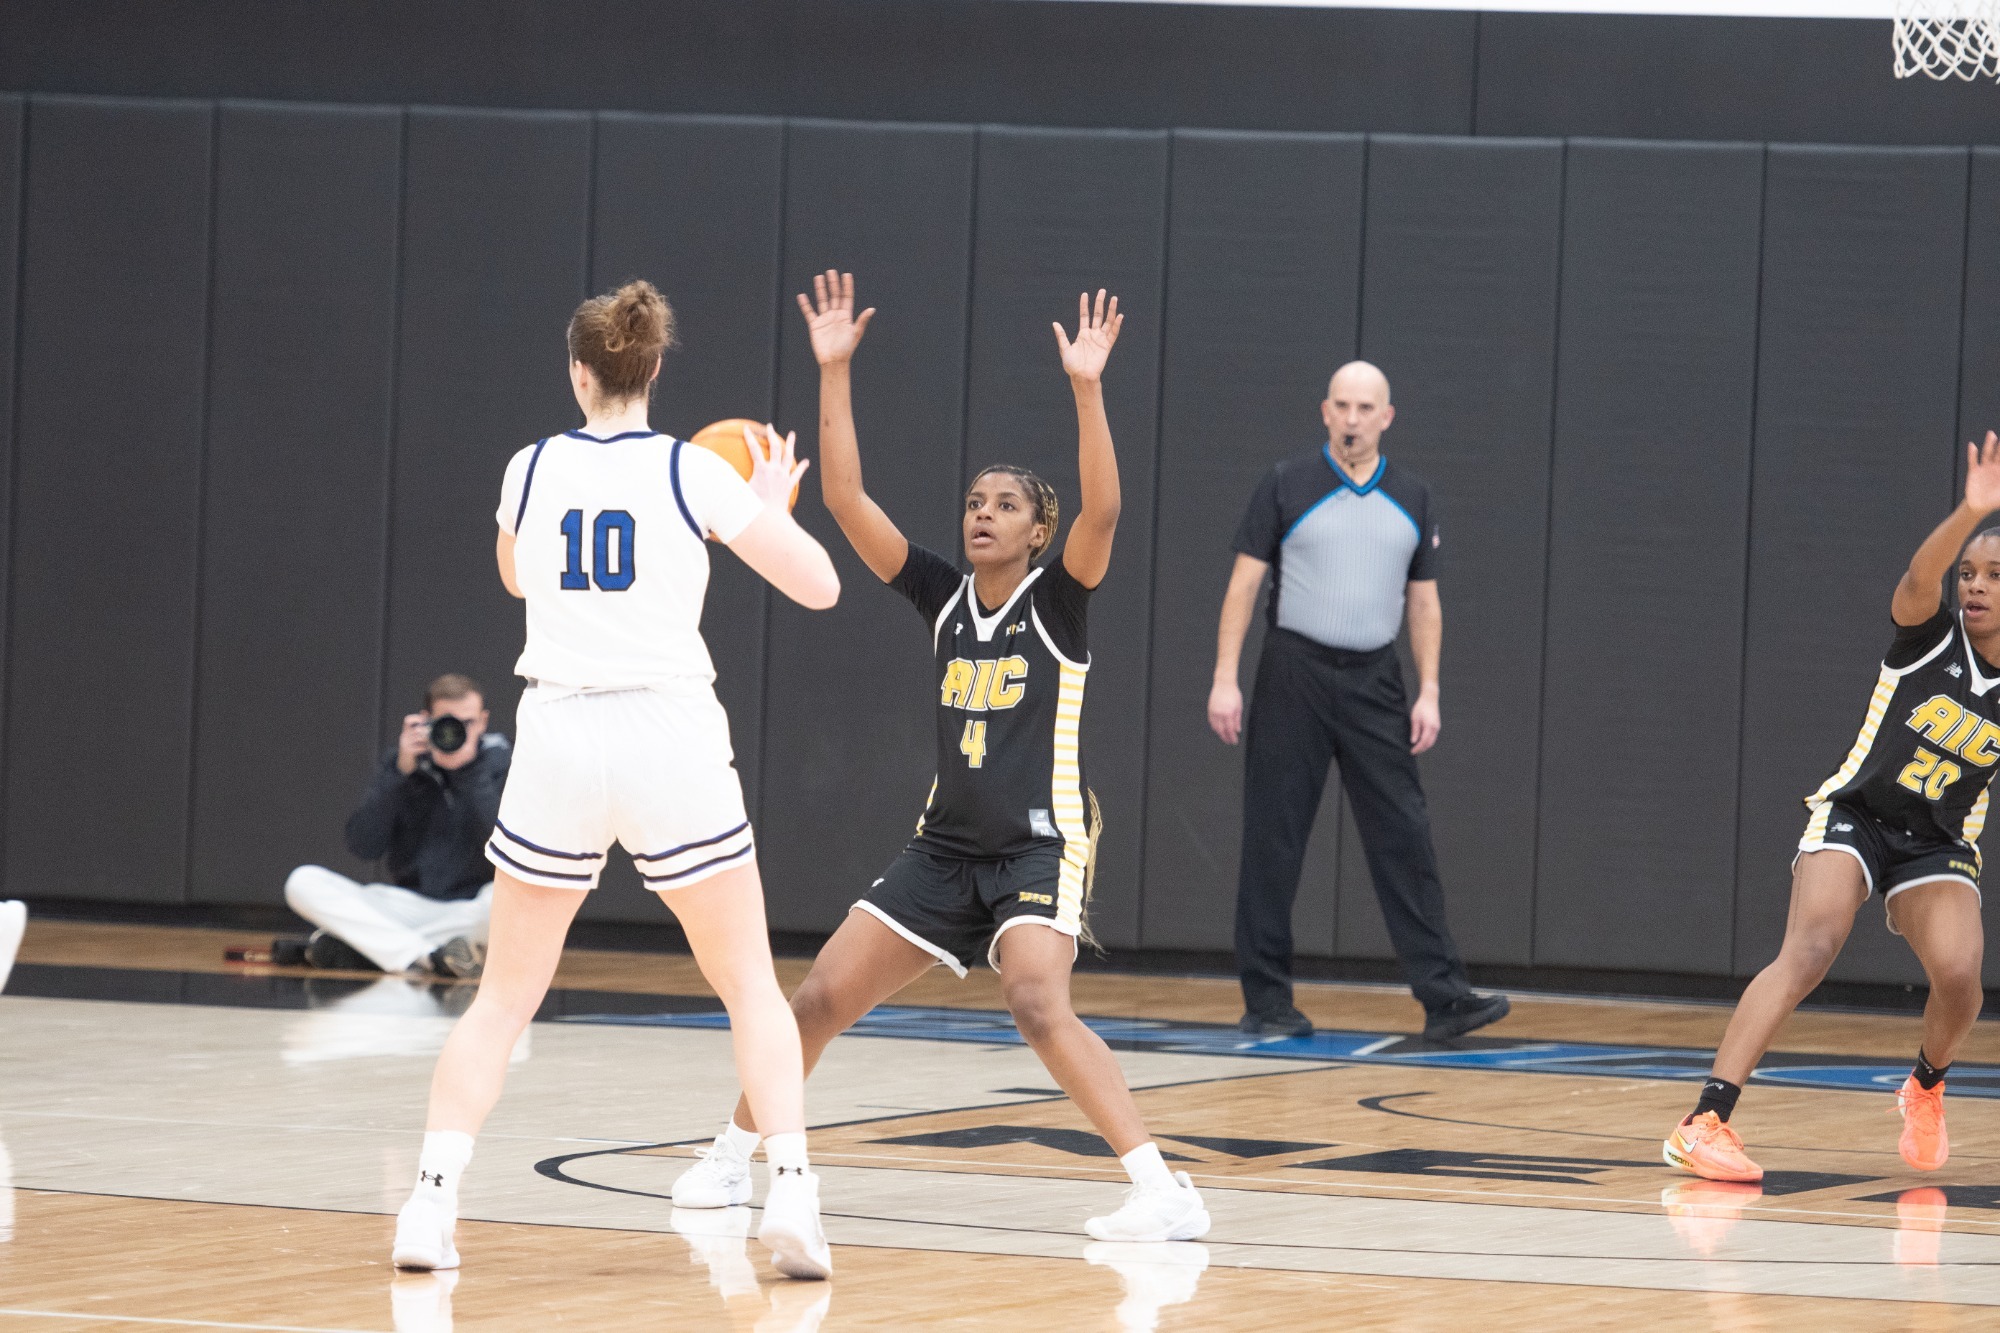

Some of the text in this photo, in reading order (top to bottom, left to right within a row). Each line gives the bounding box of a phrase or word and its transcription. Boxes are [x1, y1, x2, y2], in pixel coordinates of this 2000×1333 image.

[560, 509, 636, 592] 10
[941, 655, 1029, 711] AIC
[960, 720, 987, 769] 4
[1905, 694, 2000, 767] AIC
[1897, 746, 1961, 800] 20
